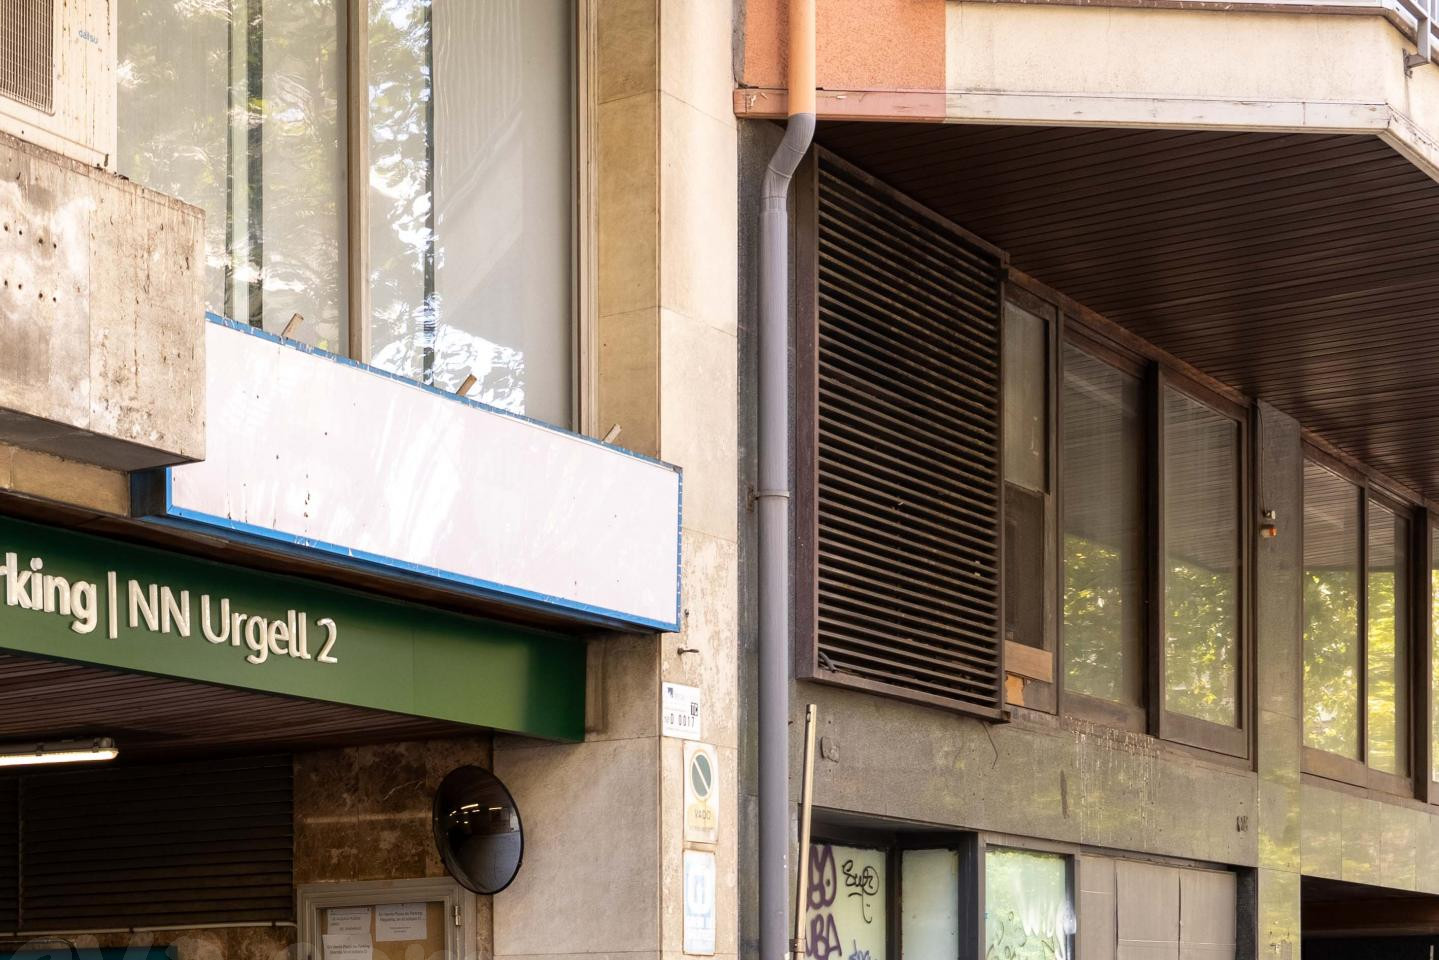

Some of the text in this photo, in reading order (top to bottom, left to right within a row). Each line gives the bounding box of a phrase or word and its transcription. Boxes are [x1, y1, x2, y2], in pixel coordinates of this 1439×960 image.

[128, 579, 192, 637] NN
[200, 593, 312, 664] Urgell
[316, 617, 338, 664] 2
